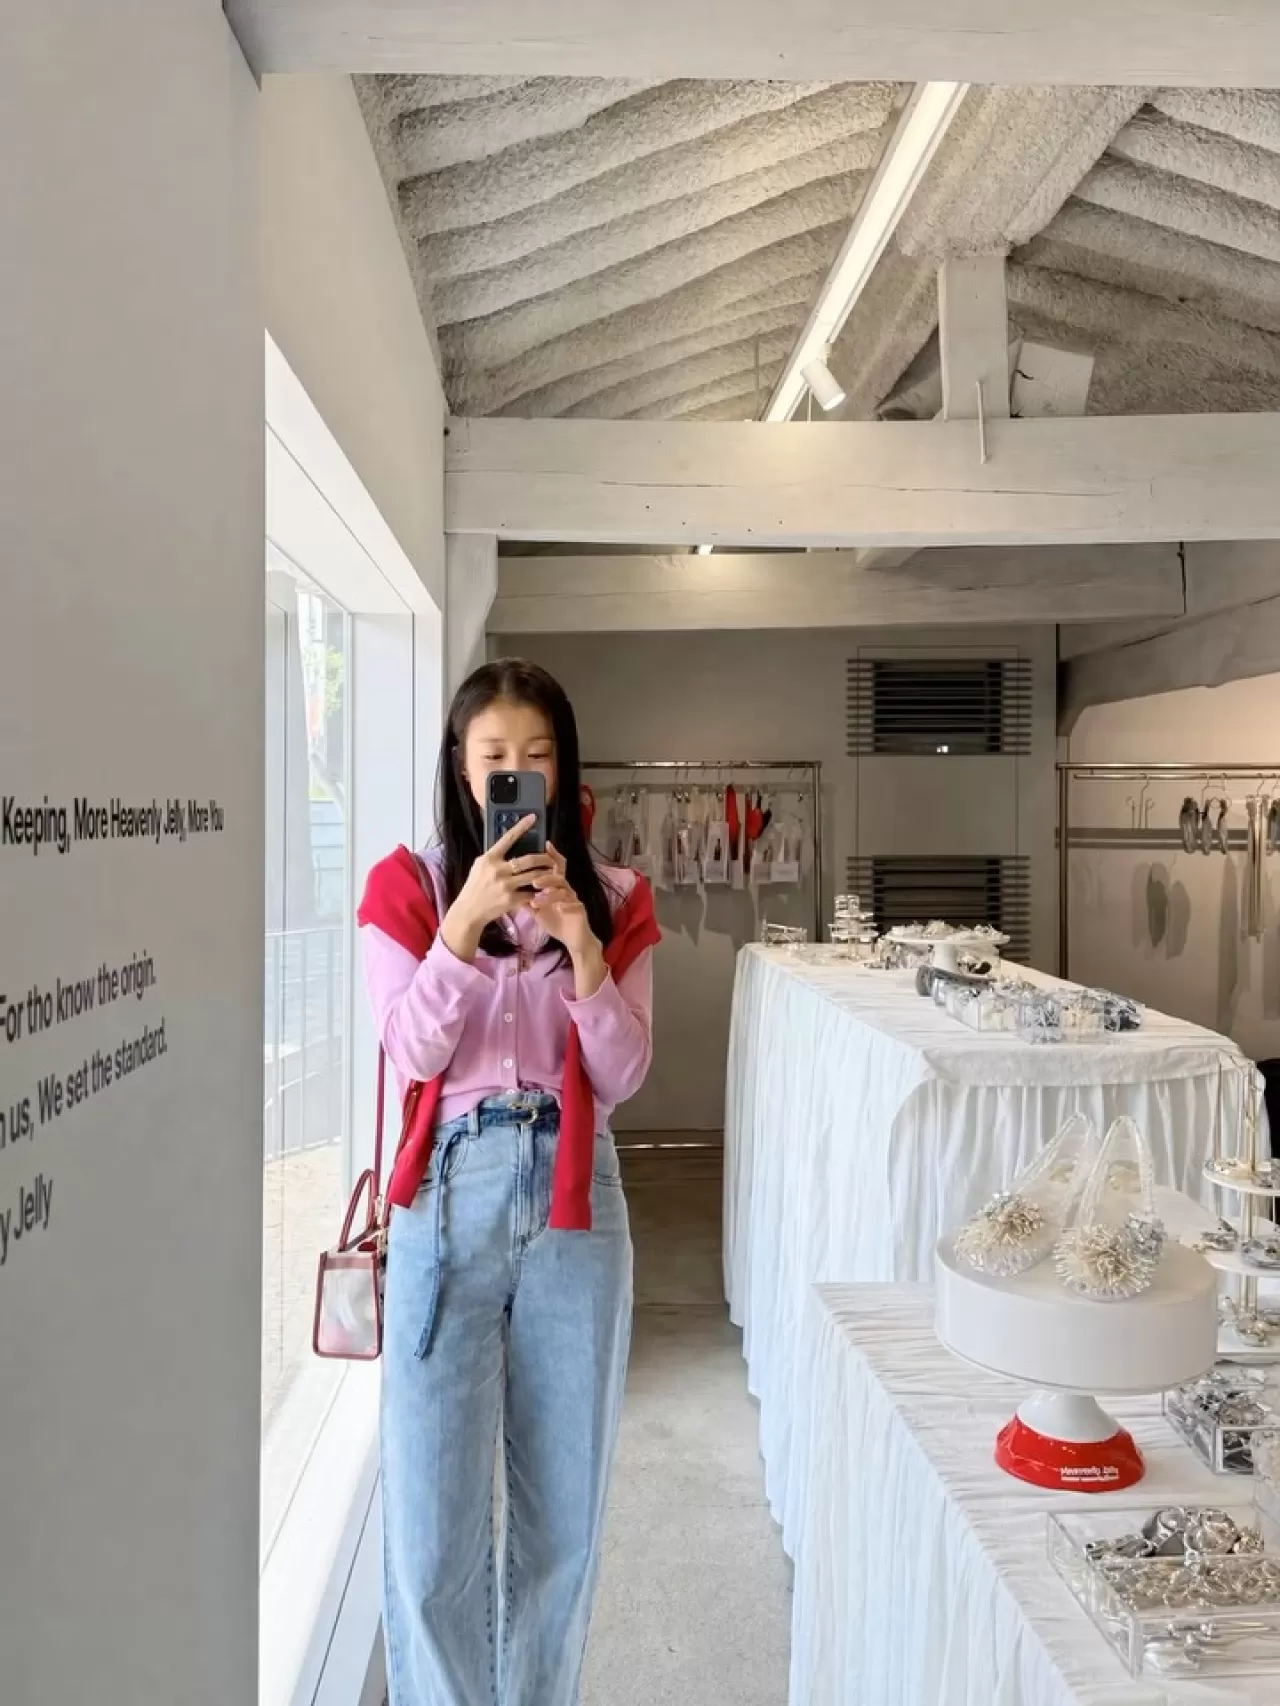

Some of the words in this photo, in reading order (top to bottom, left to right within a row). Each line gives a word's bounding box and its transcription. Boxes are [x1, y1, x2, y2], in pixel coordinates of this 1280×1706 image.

[1, 795, 71, 856] Keeping,
[74, 797, 109, 840] More
[110, 797, 162, 845] Heavenly
[56, 976, 95, 1024] know
[97, 962, 119, 1006] the
[120, 949, 156, 1001] origin.
[10, 1096, 35, 1141] us,
[37, 1073, 63, 1125] We
[66, 1059, 89, 1109] set
[92, 1049, 113, 1094] the
[114, 1016, 168, 1080] standard.
[14, 1173, 53, 1240] Jelly
